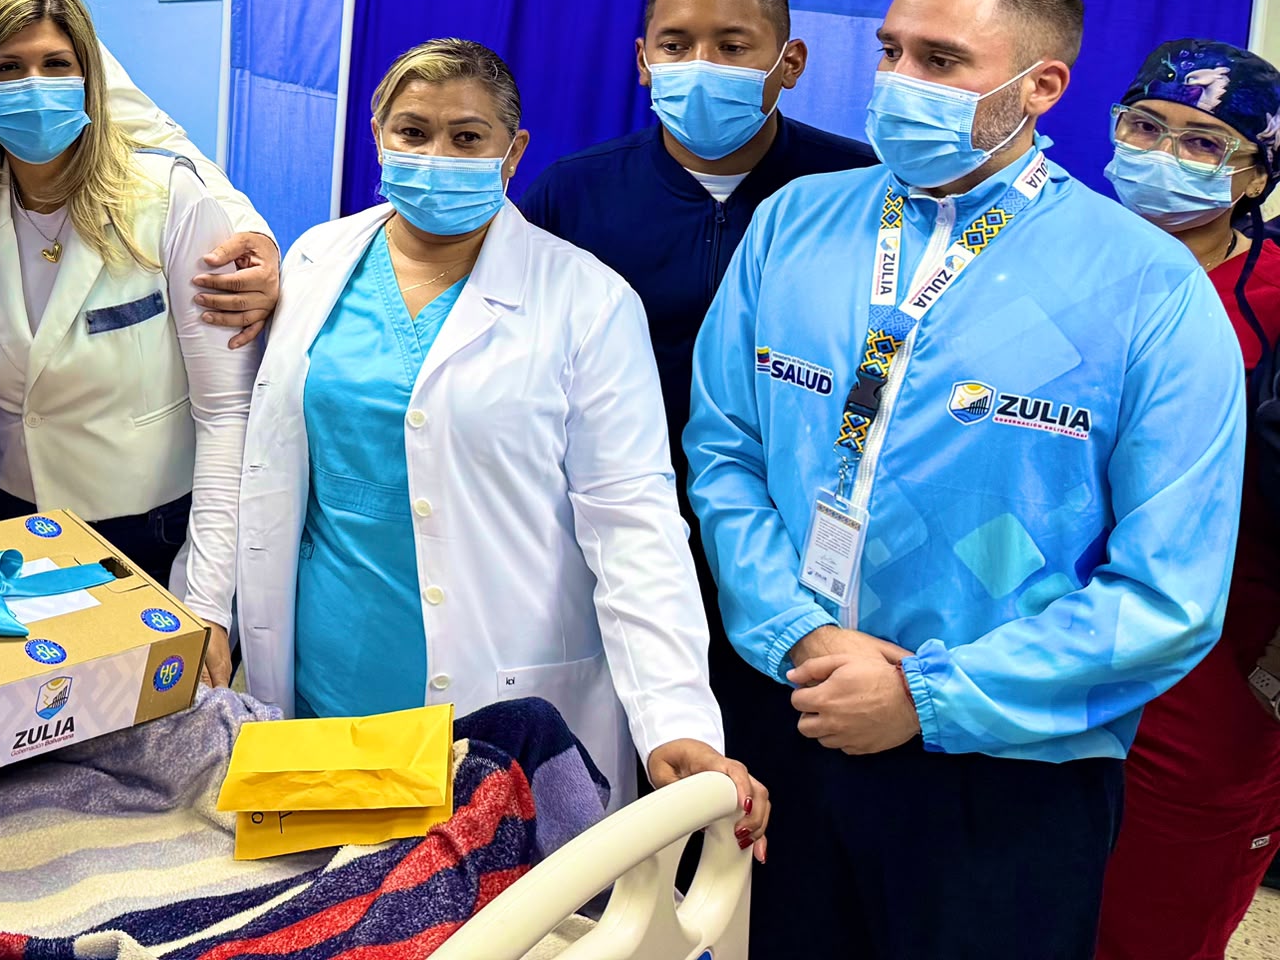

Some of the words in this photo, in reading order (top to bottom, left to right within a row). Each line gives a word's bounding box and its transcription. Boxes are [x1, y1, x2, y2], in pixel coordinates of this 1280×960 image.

[1025, 158, 1048, 188] ULIA
[880, 253, 896, 295] ZULIA
[912, 269, 953, 308] ZULIA
[770, 360, 832, 394] SALUD
[996, 394, 1090, 432] ZULIA
[11, 742, 44, 757] Gobernación
[45, 733, 75, 747] Bolivariana
[12, 716, 75, 750] ZULIA
